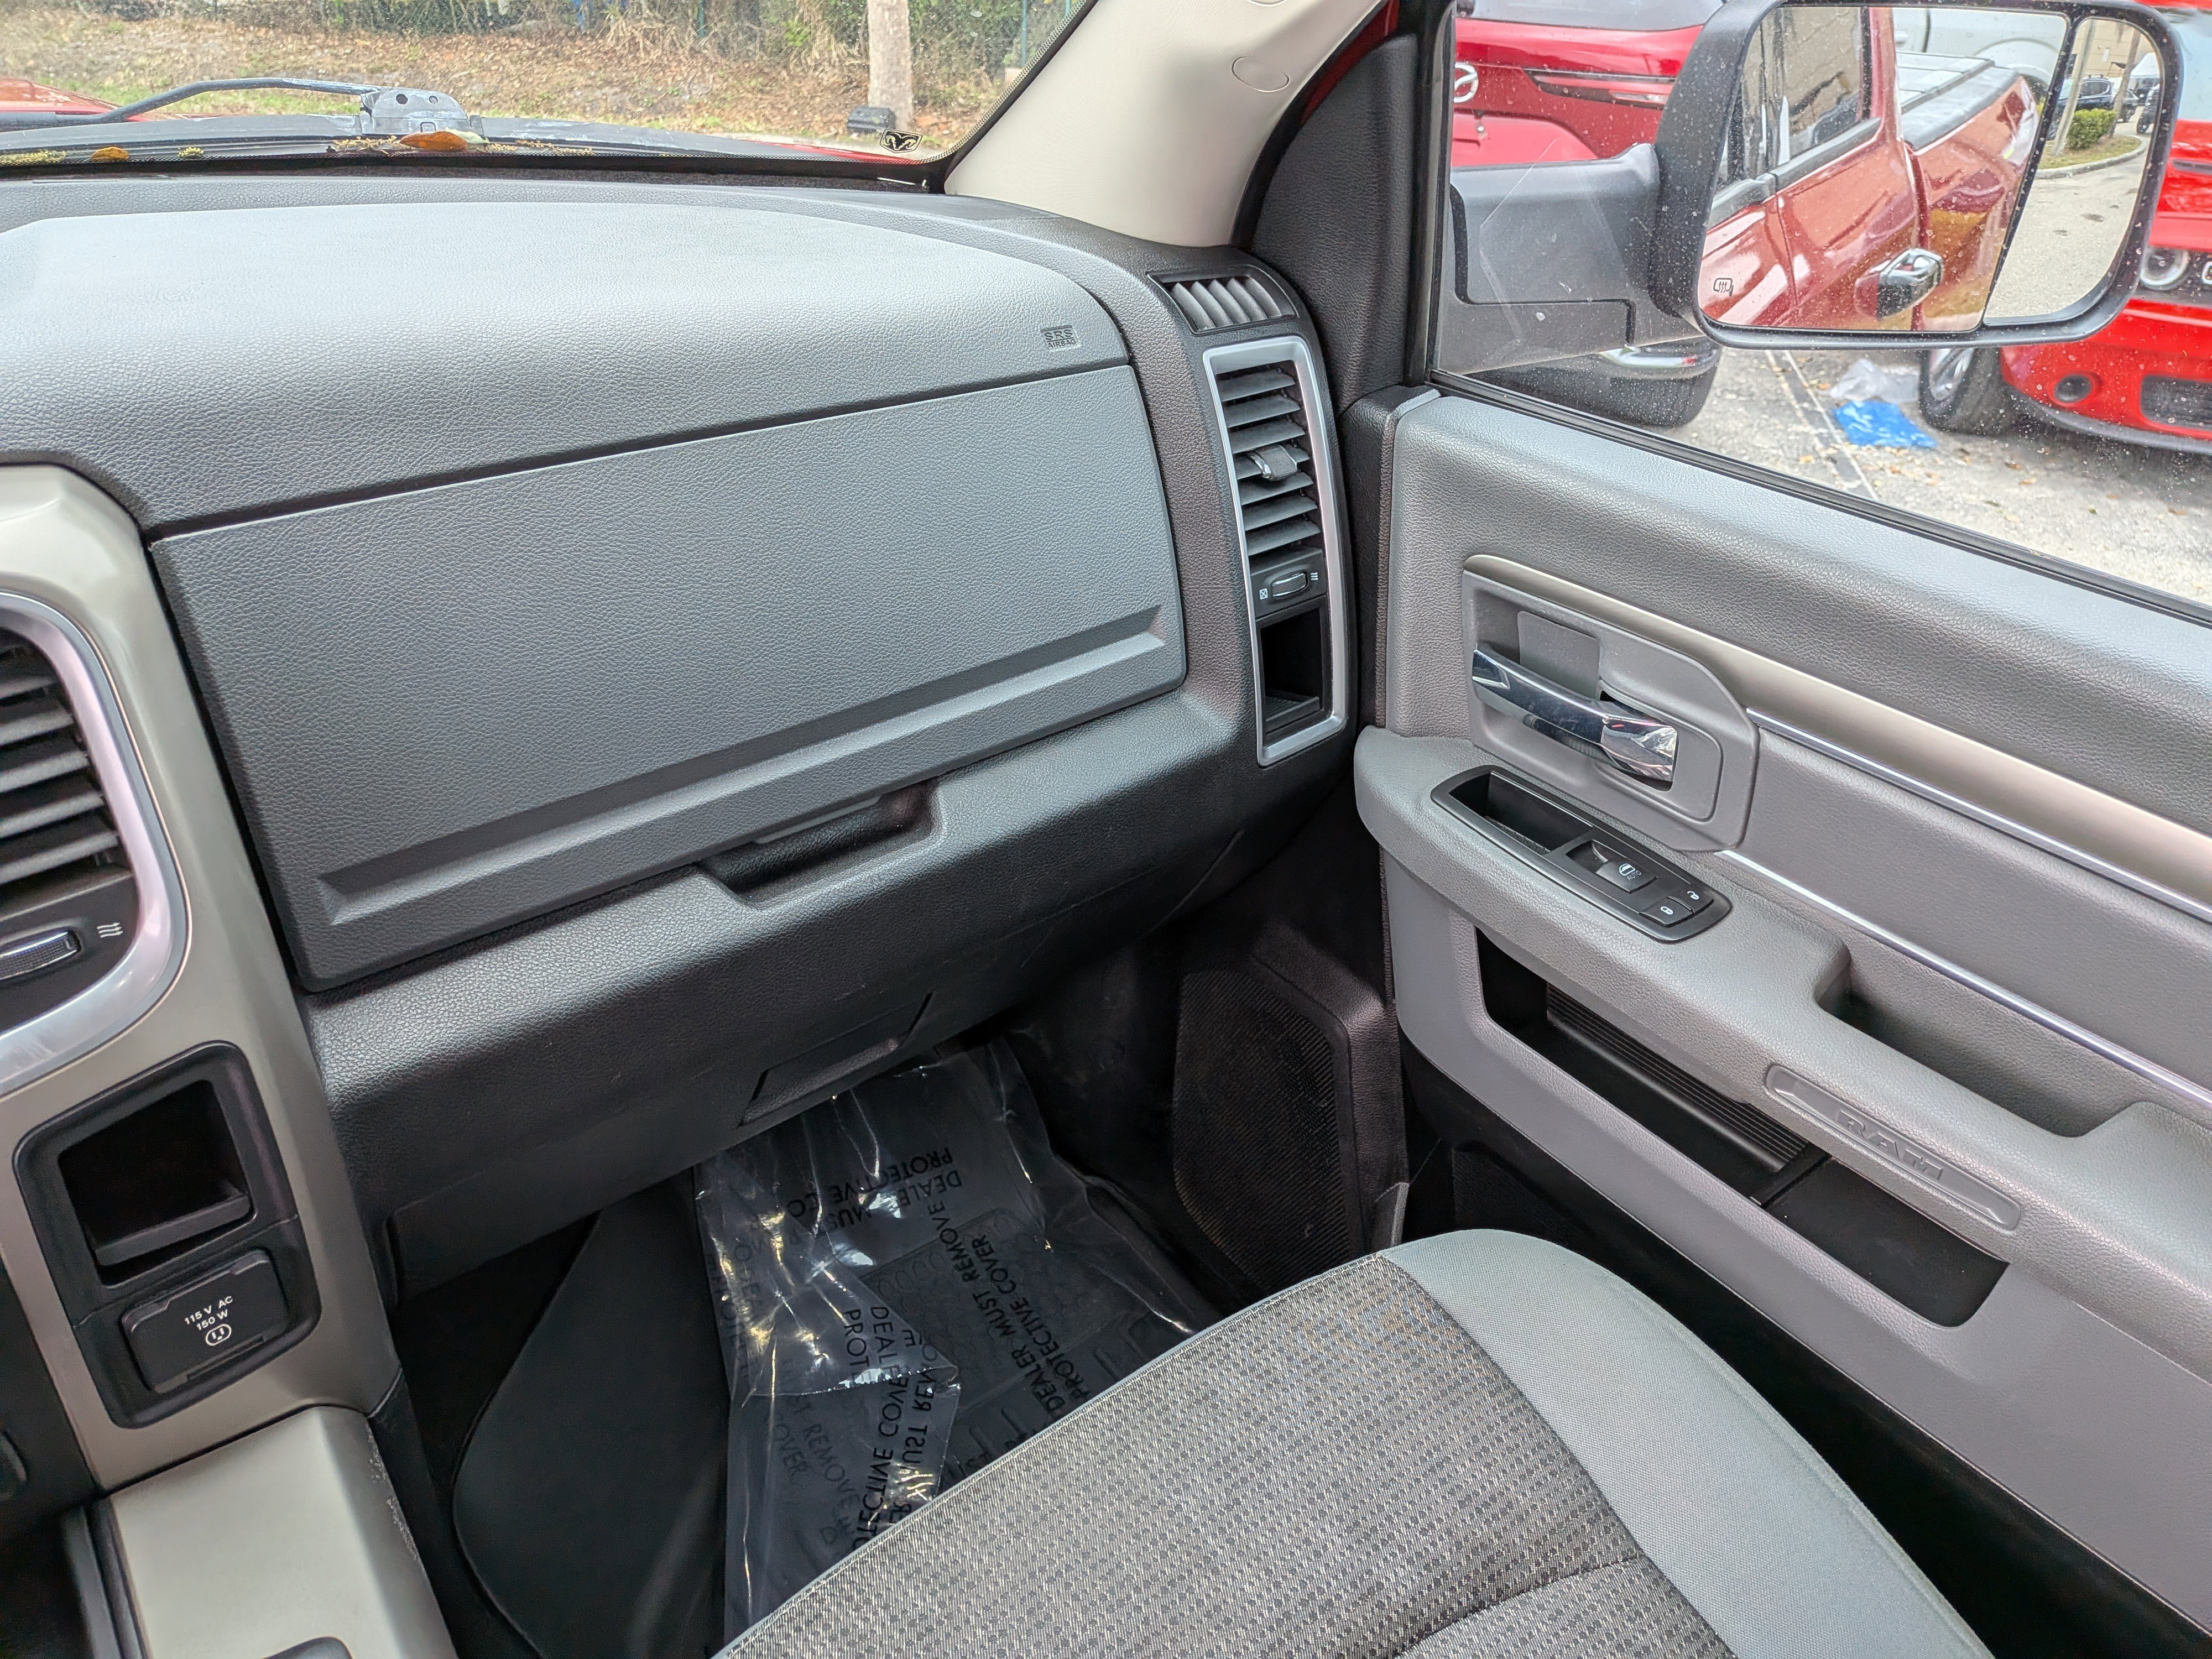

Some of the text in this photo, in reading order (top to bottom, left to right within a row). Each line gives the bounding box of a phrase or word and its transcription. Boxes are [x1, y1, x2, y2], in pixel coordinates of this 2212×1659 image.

[1044, 330, 1073, 341] SRS
[1048, 338, 1077, 348] AIRBAG
[1626, 870, 1642, 881] AUTO
[1837, 1109, 1943, 1181] RAM
[889, 1170, 962, 1207] DEALE
[184, 1296, 234, 1325] 115 V AC
[196, 1309, 229, 1331] 150 W
[927, 1201, 1065, 1413] DEALER MUST REMOVE
[971, 1234, 1091, 1404] PROTECTIVE COVER
